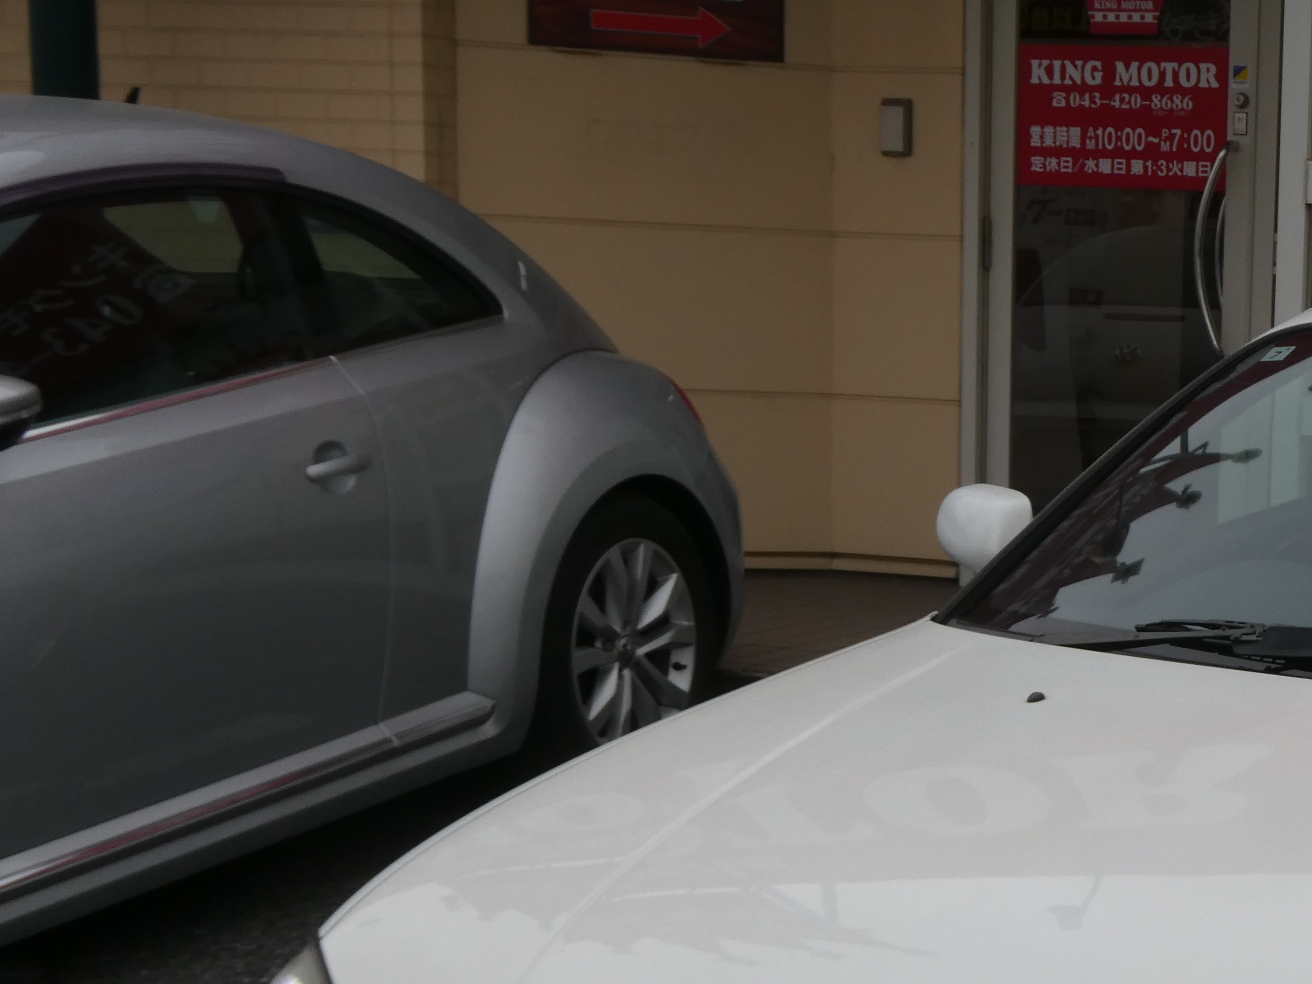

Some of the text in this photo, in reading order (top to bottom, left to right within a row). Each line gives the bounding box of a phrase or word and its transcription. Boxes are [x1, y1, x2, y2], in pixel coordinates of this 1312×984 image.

[1030, 59, 1219, 88] KING MOTOR
[1029, 125, 1081, 148] 営業時間
